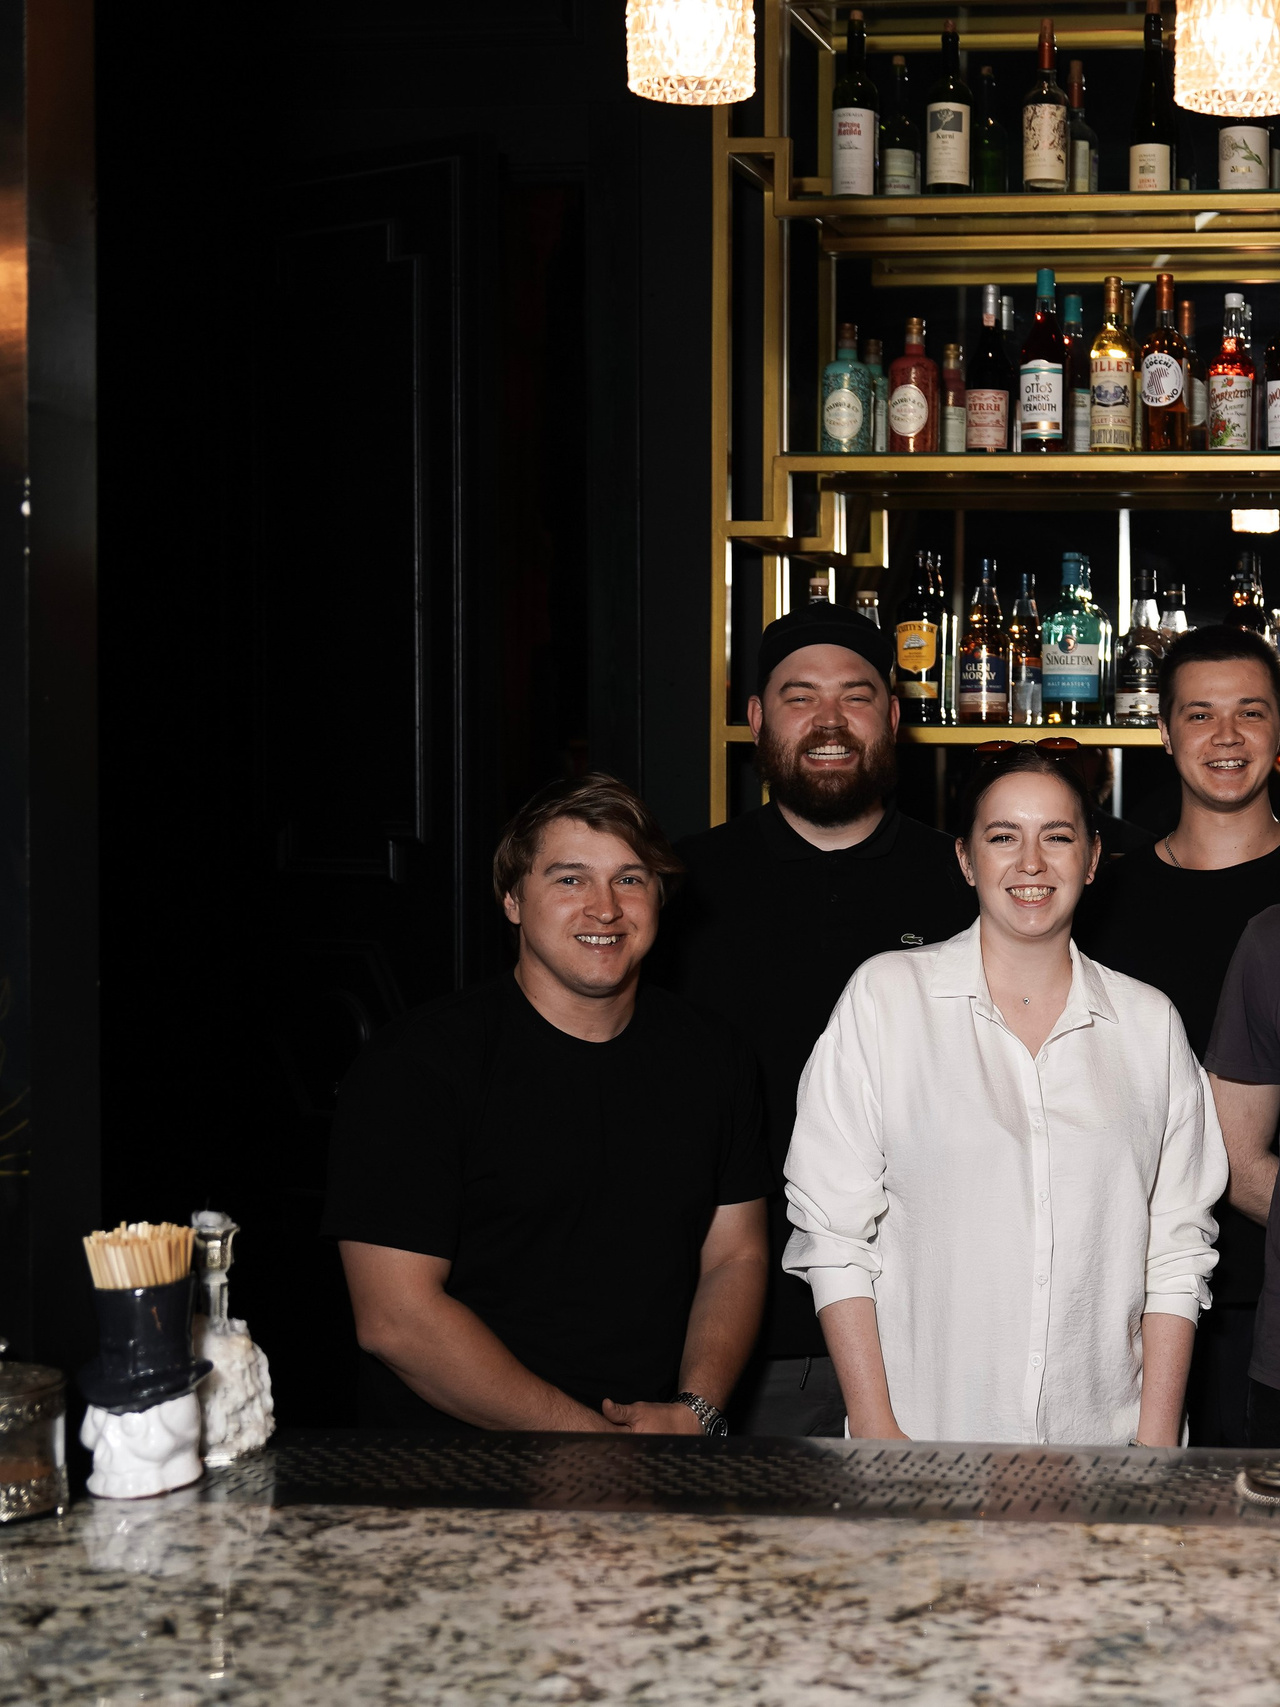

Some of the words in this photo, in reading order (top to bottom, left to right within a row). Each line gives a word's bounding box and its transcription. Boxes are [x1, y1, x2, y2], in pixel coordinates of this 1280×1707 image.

[1146, 359, 1172, 370] COCCHI
[1025, 382, 1053, 394] OTTO'S
[968, 403, 1000, 411] BYRRH
[1023, 404, 1056, 412] VERMOUTH
[917, 622, 935, 633] SRK
[1046, 654, 1093, 666] SINGLETON
[966, 663, 990, 671] GLEN
[962, 672, 996, 680] MORAY
